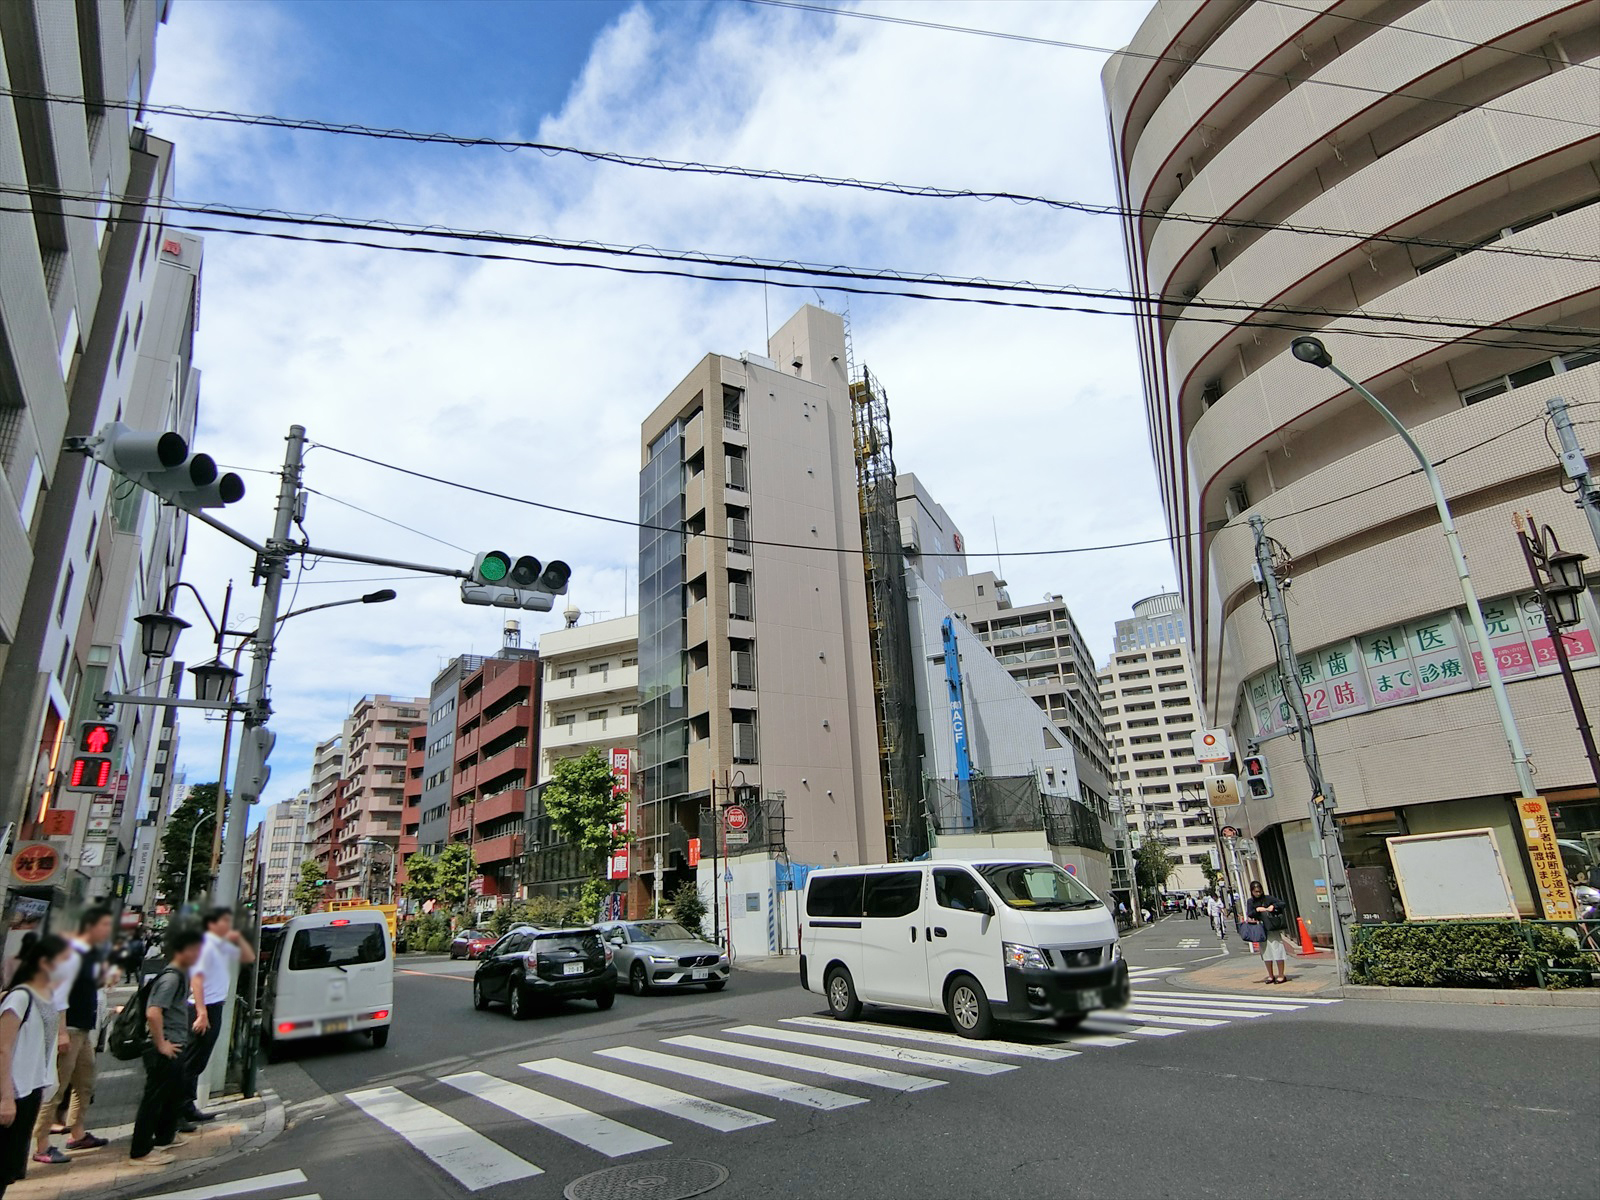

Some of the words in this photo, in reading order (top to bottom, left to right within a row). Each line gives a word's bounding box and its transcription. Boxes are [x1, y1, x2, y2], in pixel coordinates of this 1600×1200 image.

[613, 753, 628, 872] 昭和庫
[1536, 814, 1567, 898] 歩行者は横断歩道を
